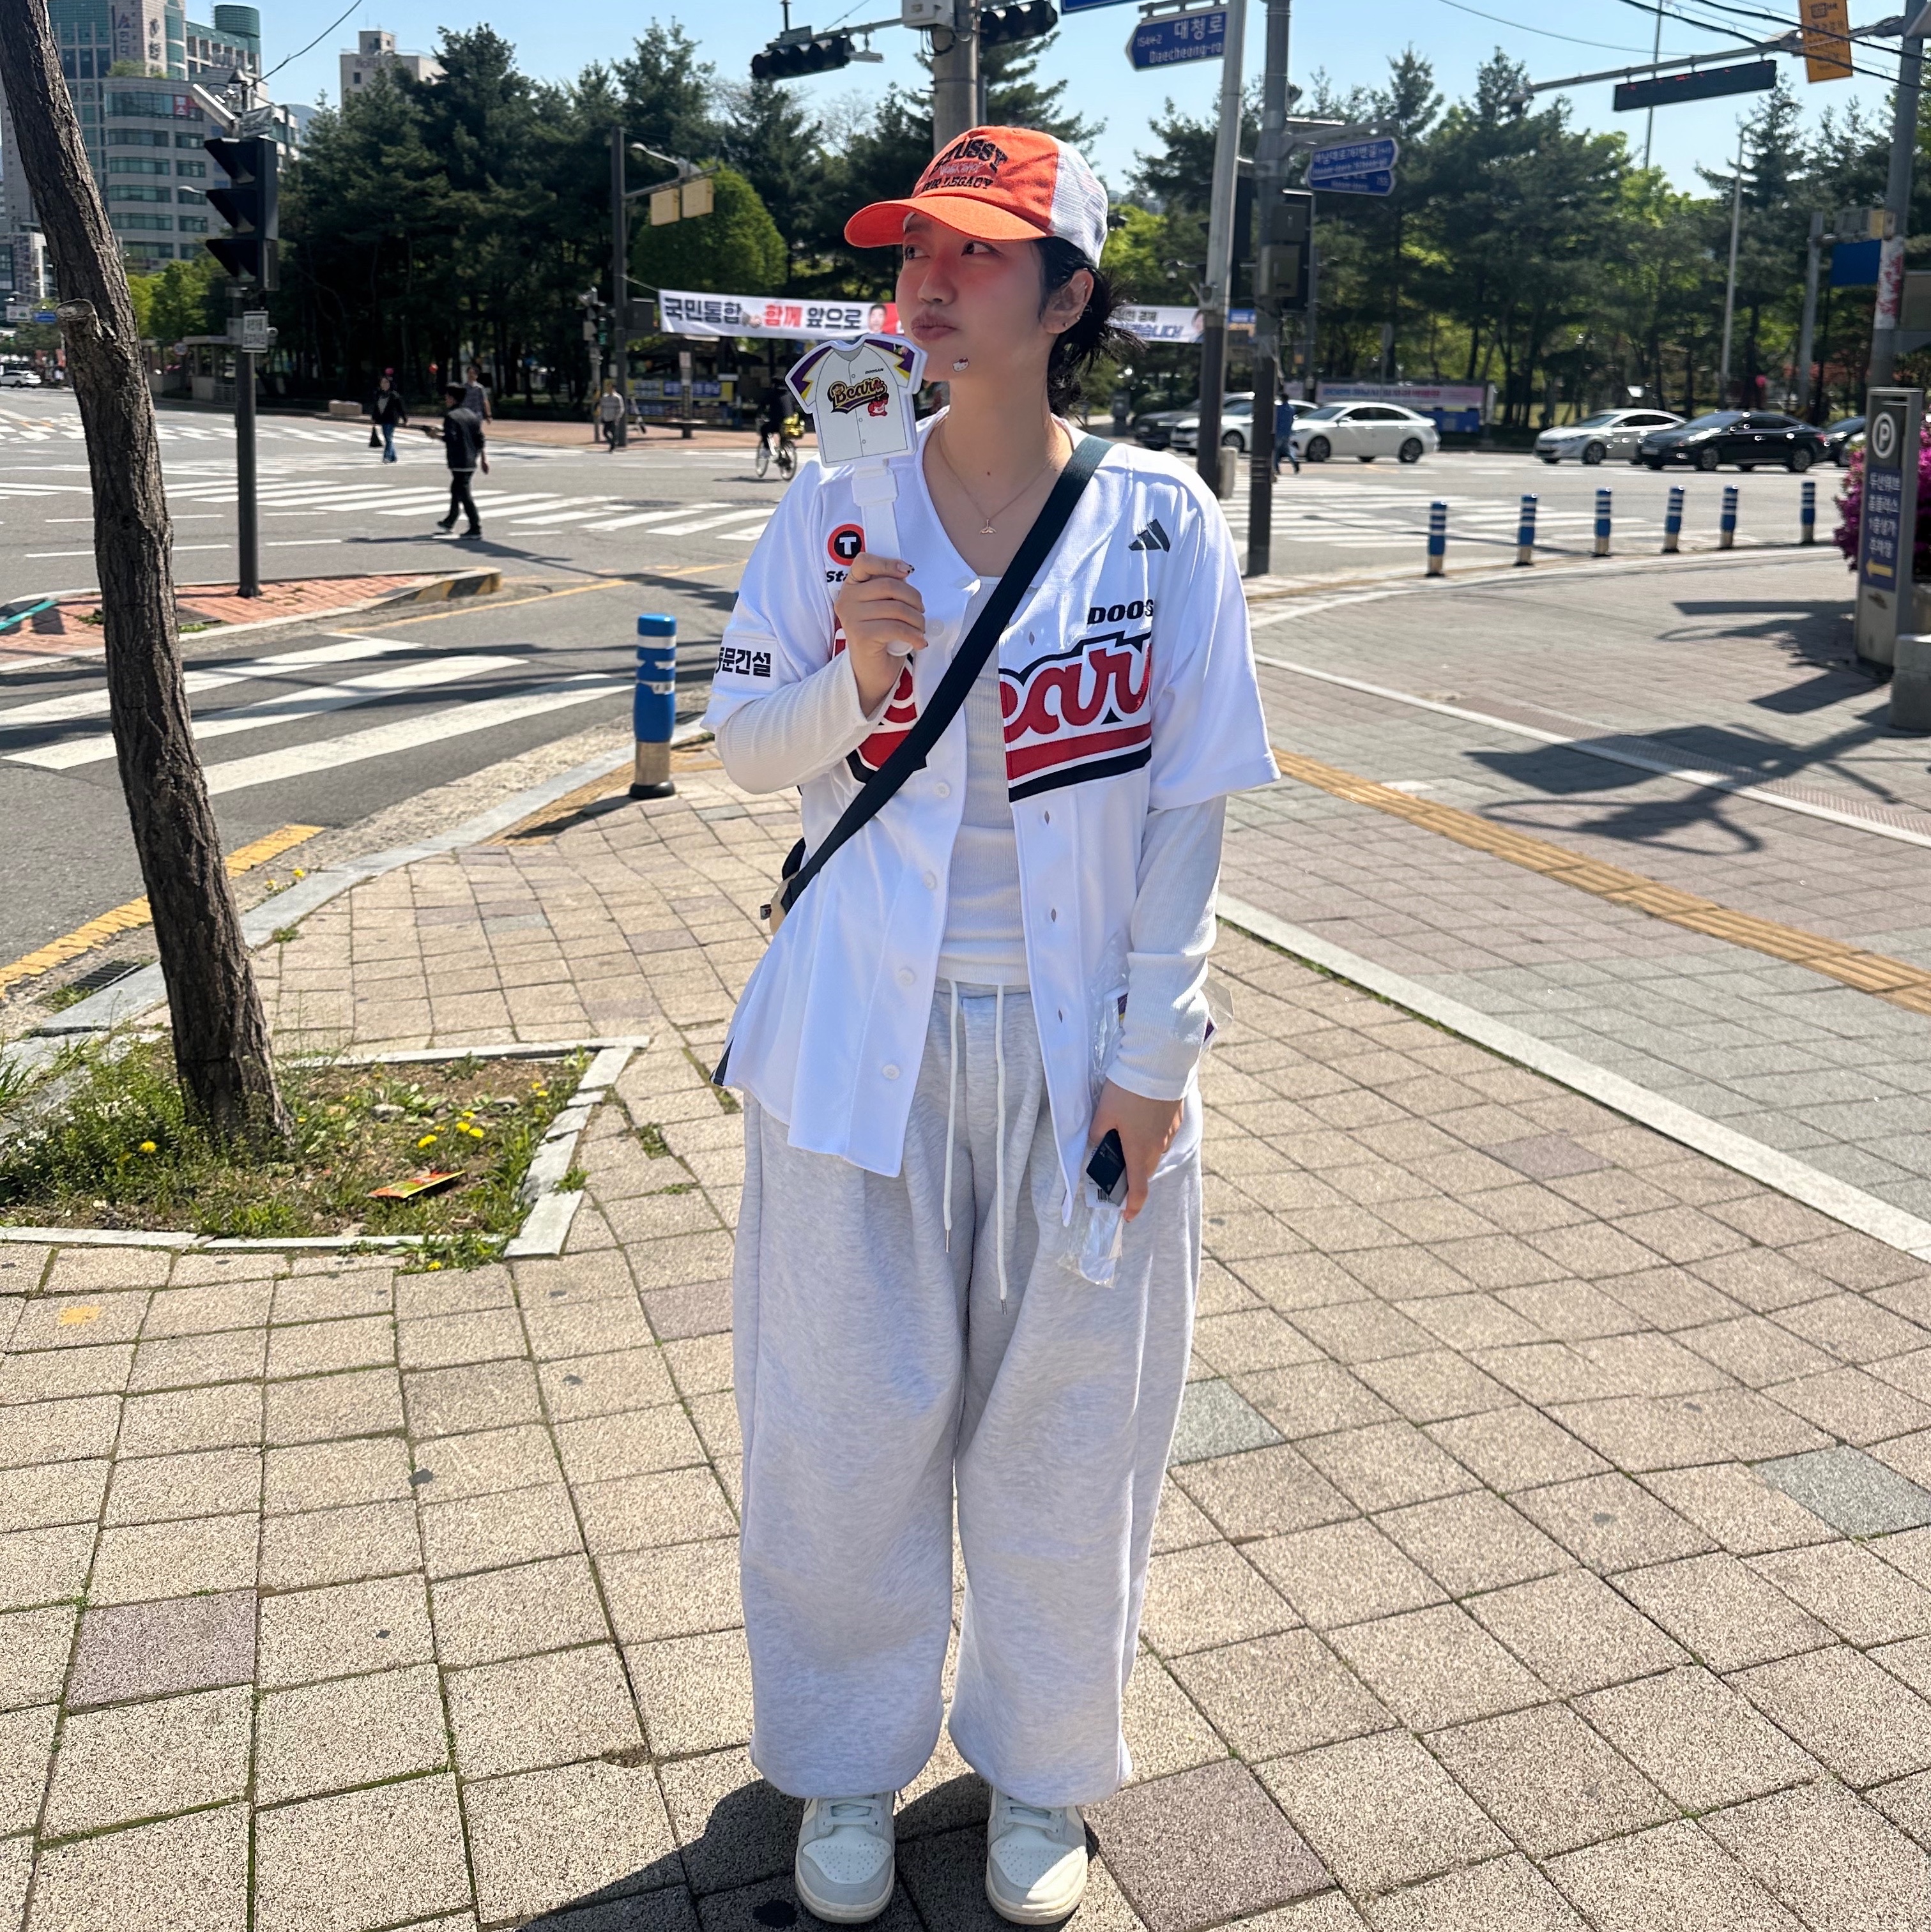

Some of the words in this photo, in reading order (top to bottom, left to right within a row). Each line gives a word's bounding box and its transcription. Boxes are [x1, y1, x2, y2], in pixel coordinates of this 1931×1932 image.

[1174, 14, 1223, 40] 대청로
[1149, 42, 1223, 63] Daecheong-ro
[664, 297, 742, 325] 국민통합
[765, 303, 803, 328] 함께
[806, 307, 862, 330] 앞으로
[828, 377, 888, 410] Bears
[839, 537, 857, 555] T
